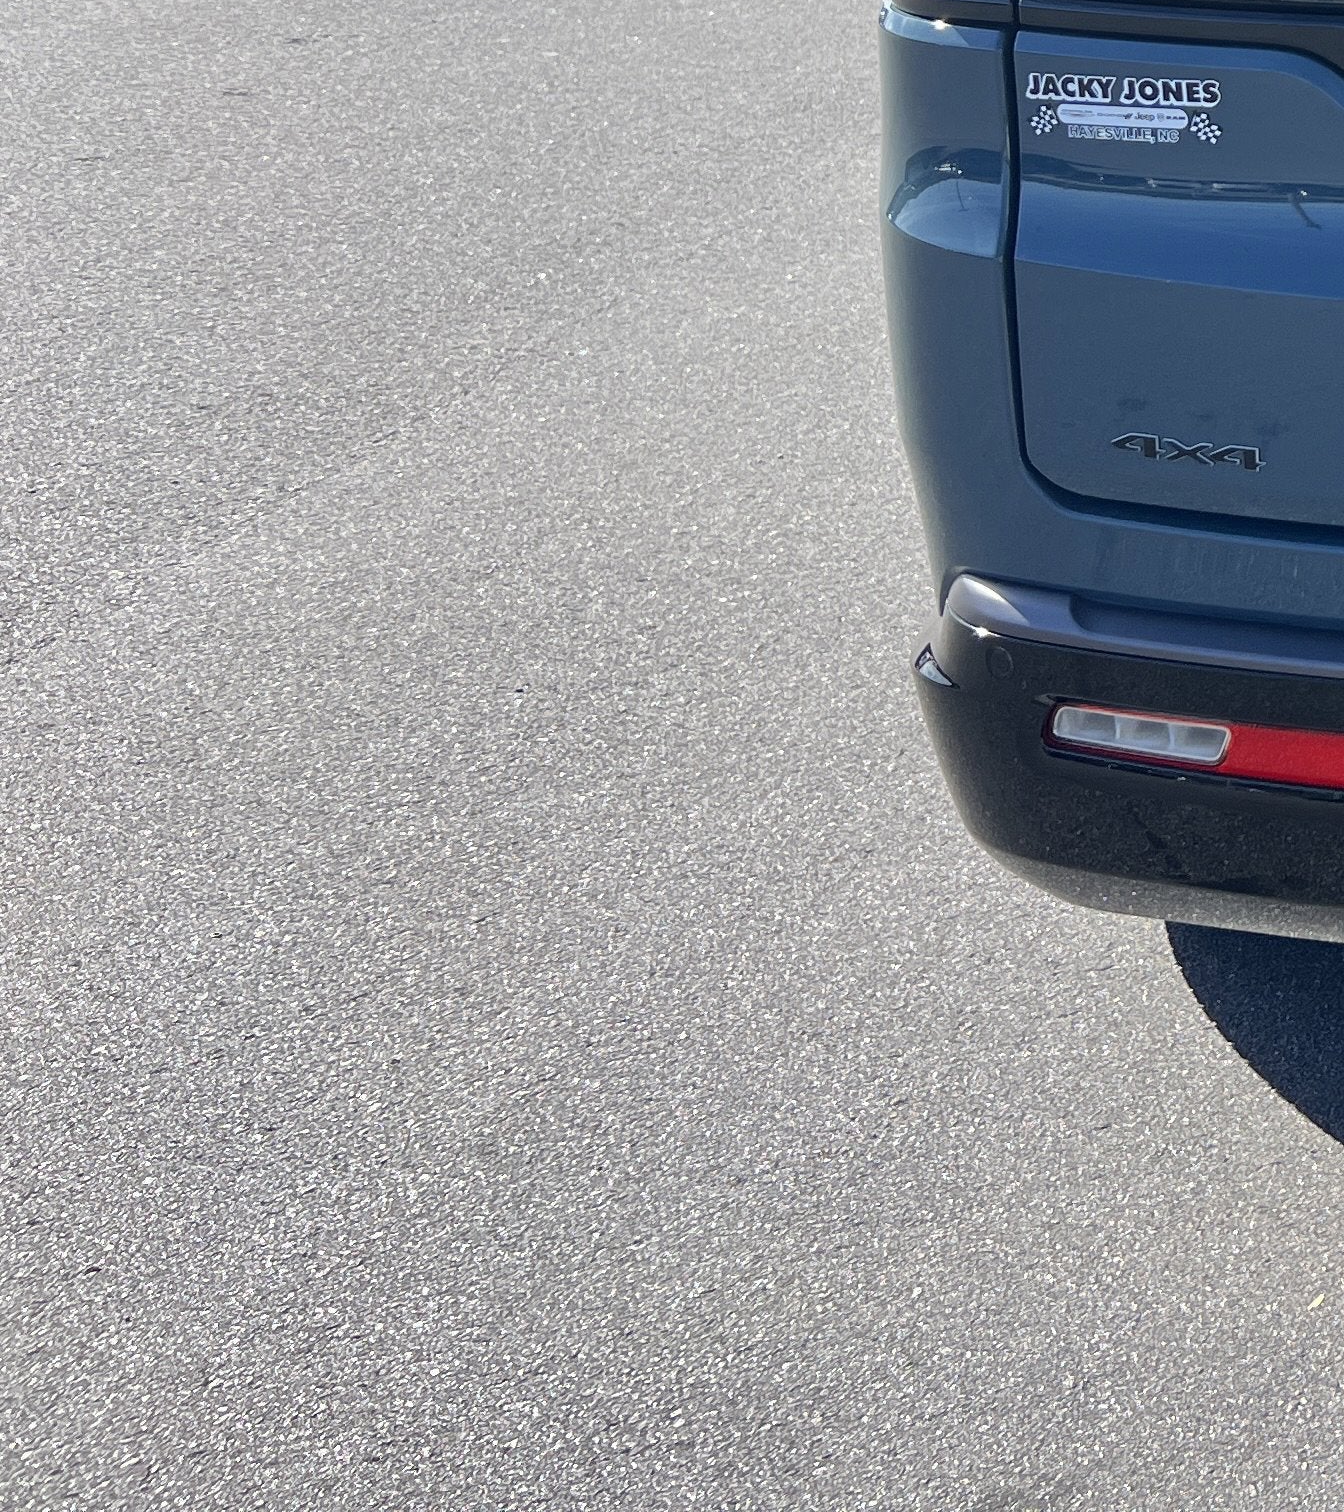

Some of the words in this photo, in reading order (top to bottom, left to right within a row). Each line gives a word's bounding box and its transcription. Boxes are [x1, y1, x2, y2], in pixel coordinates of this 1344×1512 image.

[1025, 72, 1117, 103] JACKY
[1119, 76, 1222, 108] JONES
[1134, 111, 1155, 122] Jeep
[1067, 124, 1156, 144] HAYESVILLE,
[1156, 128, 1180, 144] NC
